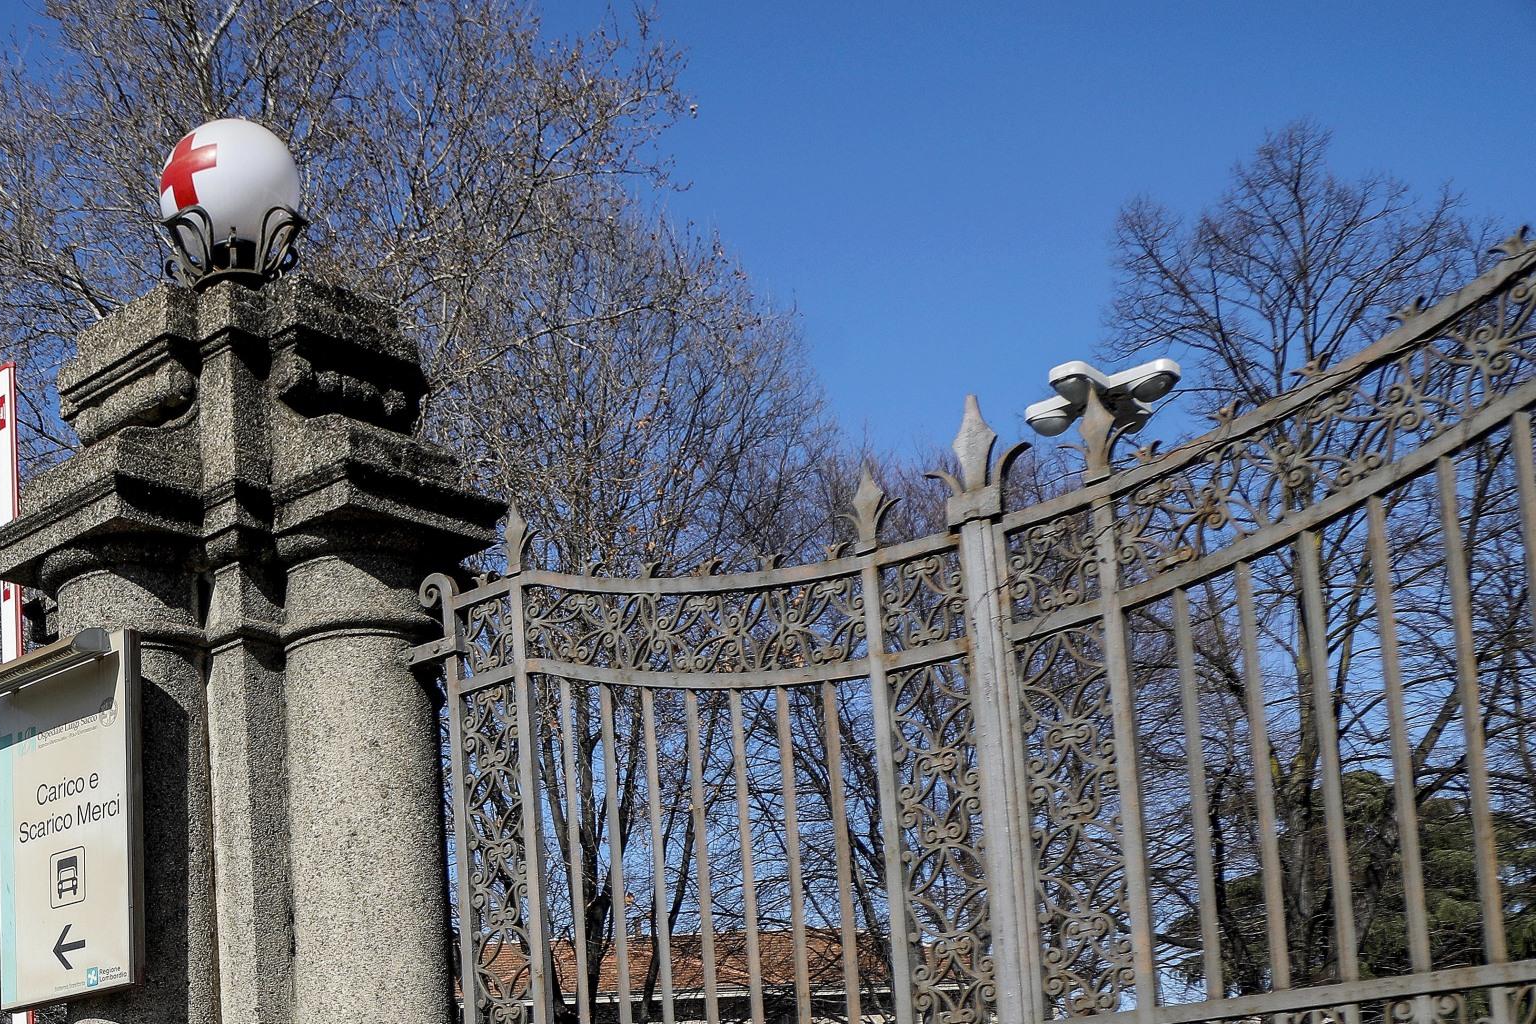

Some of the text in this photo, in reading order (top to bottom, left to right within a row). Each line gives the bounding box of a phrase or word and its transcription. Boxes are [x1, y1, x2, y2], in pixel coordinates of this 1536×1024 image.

[36, 772, 99, 806] Carico e
[19, 793, 120, 844] Scarico Merci
[99, 966, 128, 983] Regione Lombardia
